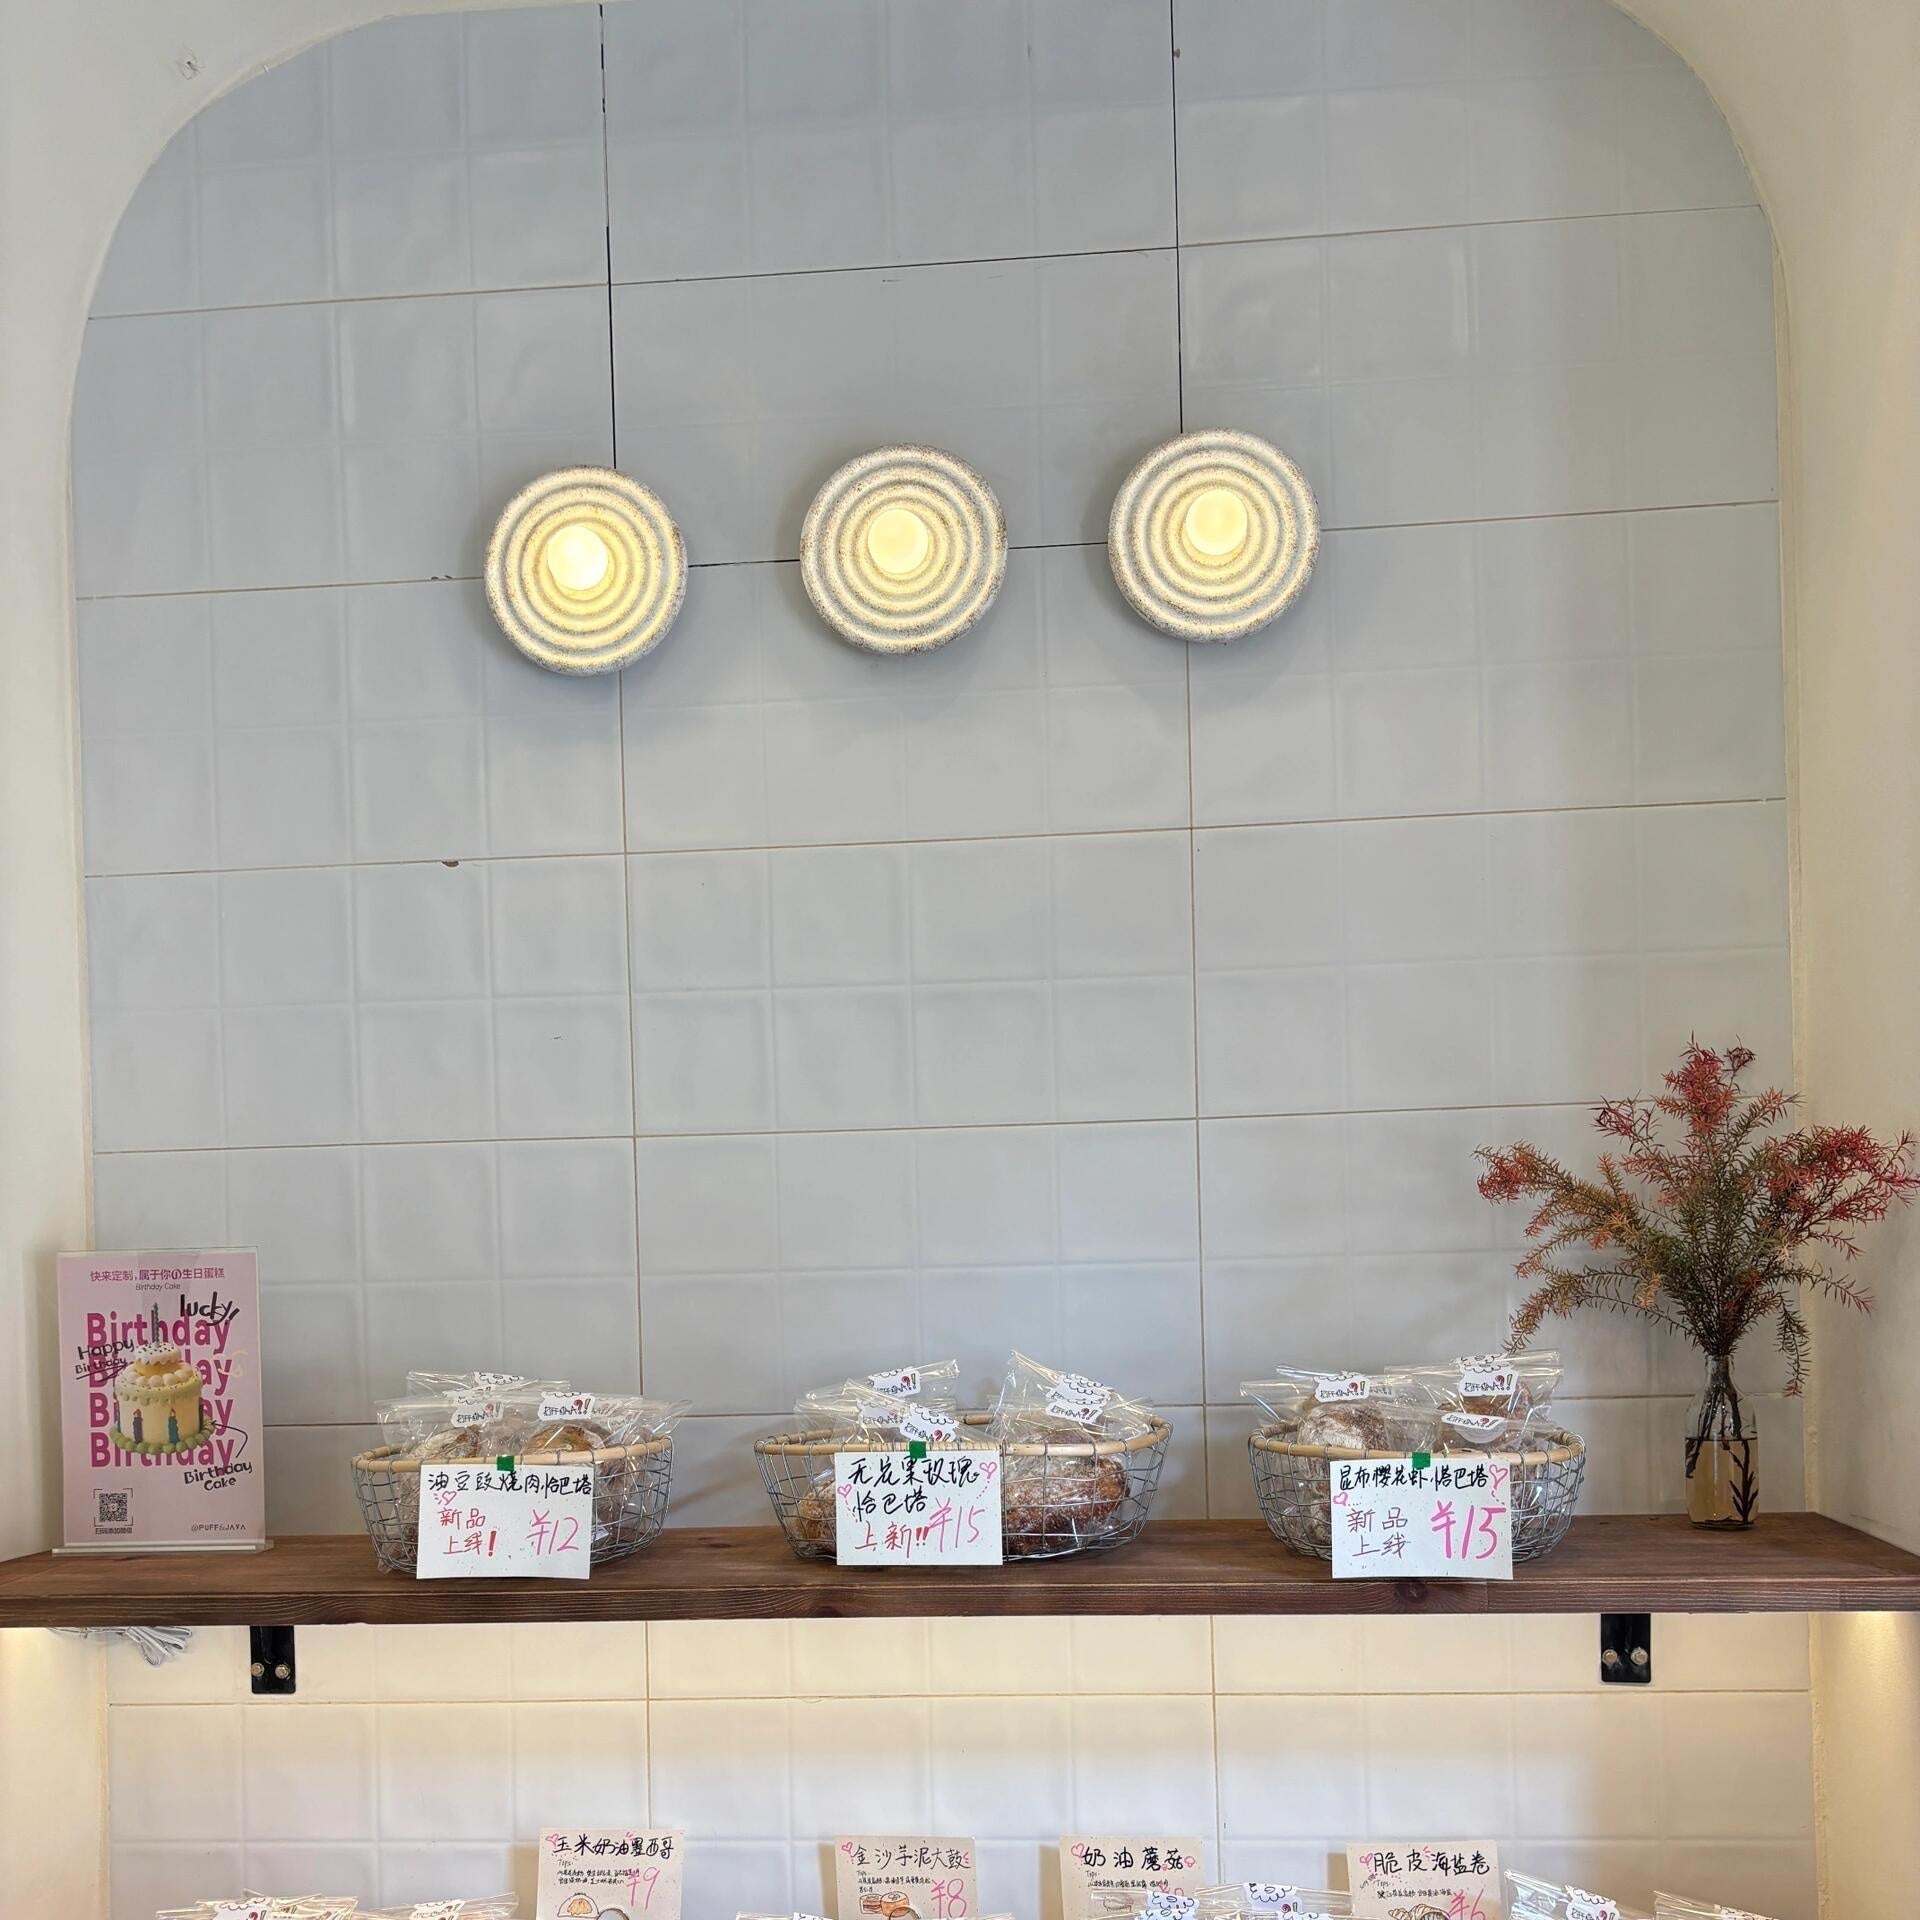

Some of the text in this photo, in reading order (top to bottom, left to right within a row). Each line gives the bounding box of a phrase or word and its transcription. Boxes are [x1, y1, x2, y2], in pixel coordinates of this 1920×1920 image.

[135, 1282, 181, 1291] Birthday Cake
[77, 1339, 135, 1360] Happy
[184, 1461, 253, 1485] Birthday
[204, 1477, 237, 1491] Cake
[852, 1485, 928, 1522] 恰巴塔
[438, 1507, 486, 1530] 新品
[1346, 1506, 1408, 1533] 新品
[1430, 1500, 1507, 1560] ¥15
[526, 1509, 579, 1556] ¥12
[1352, 1532, 1411, 1559] 上线
[853, 1844, 971, 1870] 金沙芋泥大鼓
[1082, 1846, 1184, 1871] 奶油蘑菇
[1373, 1850, 1490, 1876] 脆皮海盐卷
